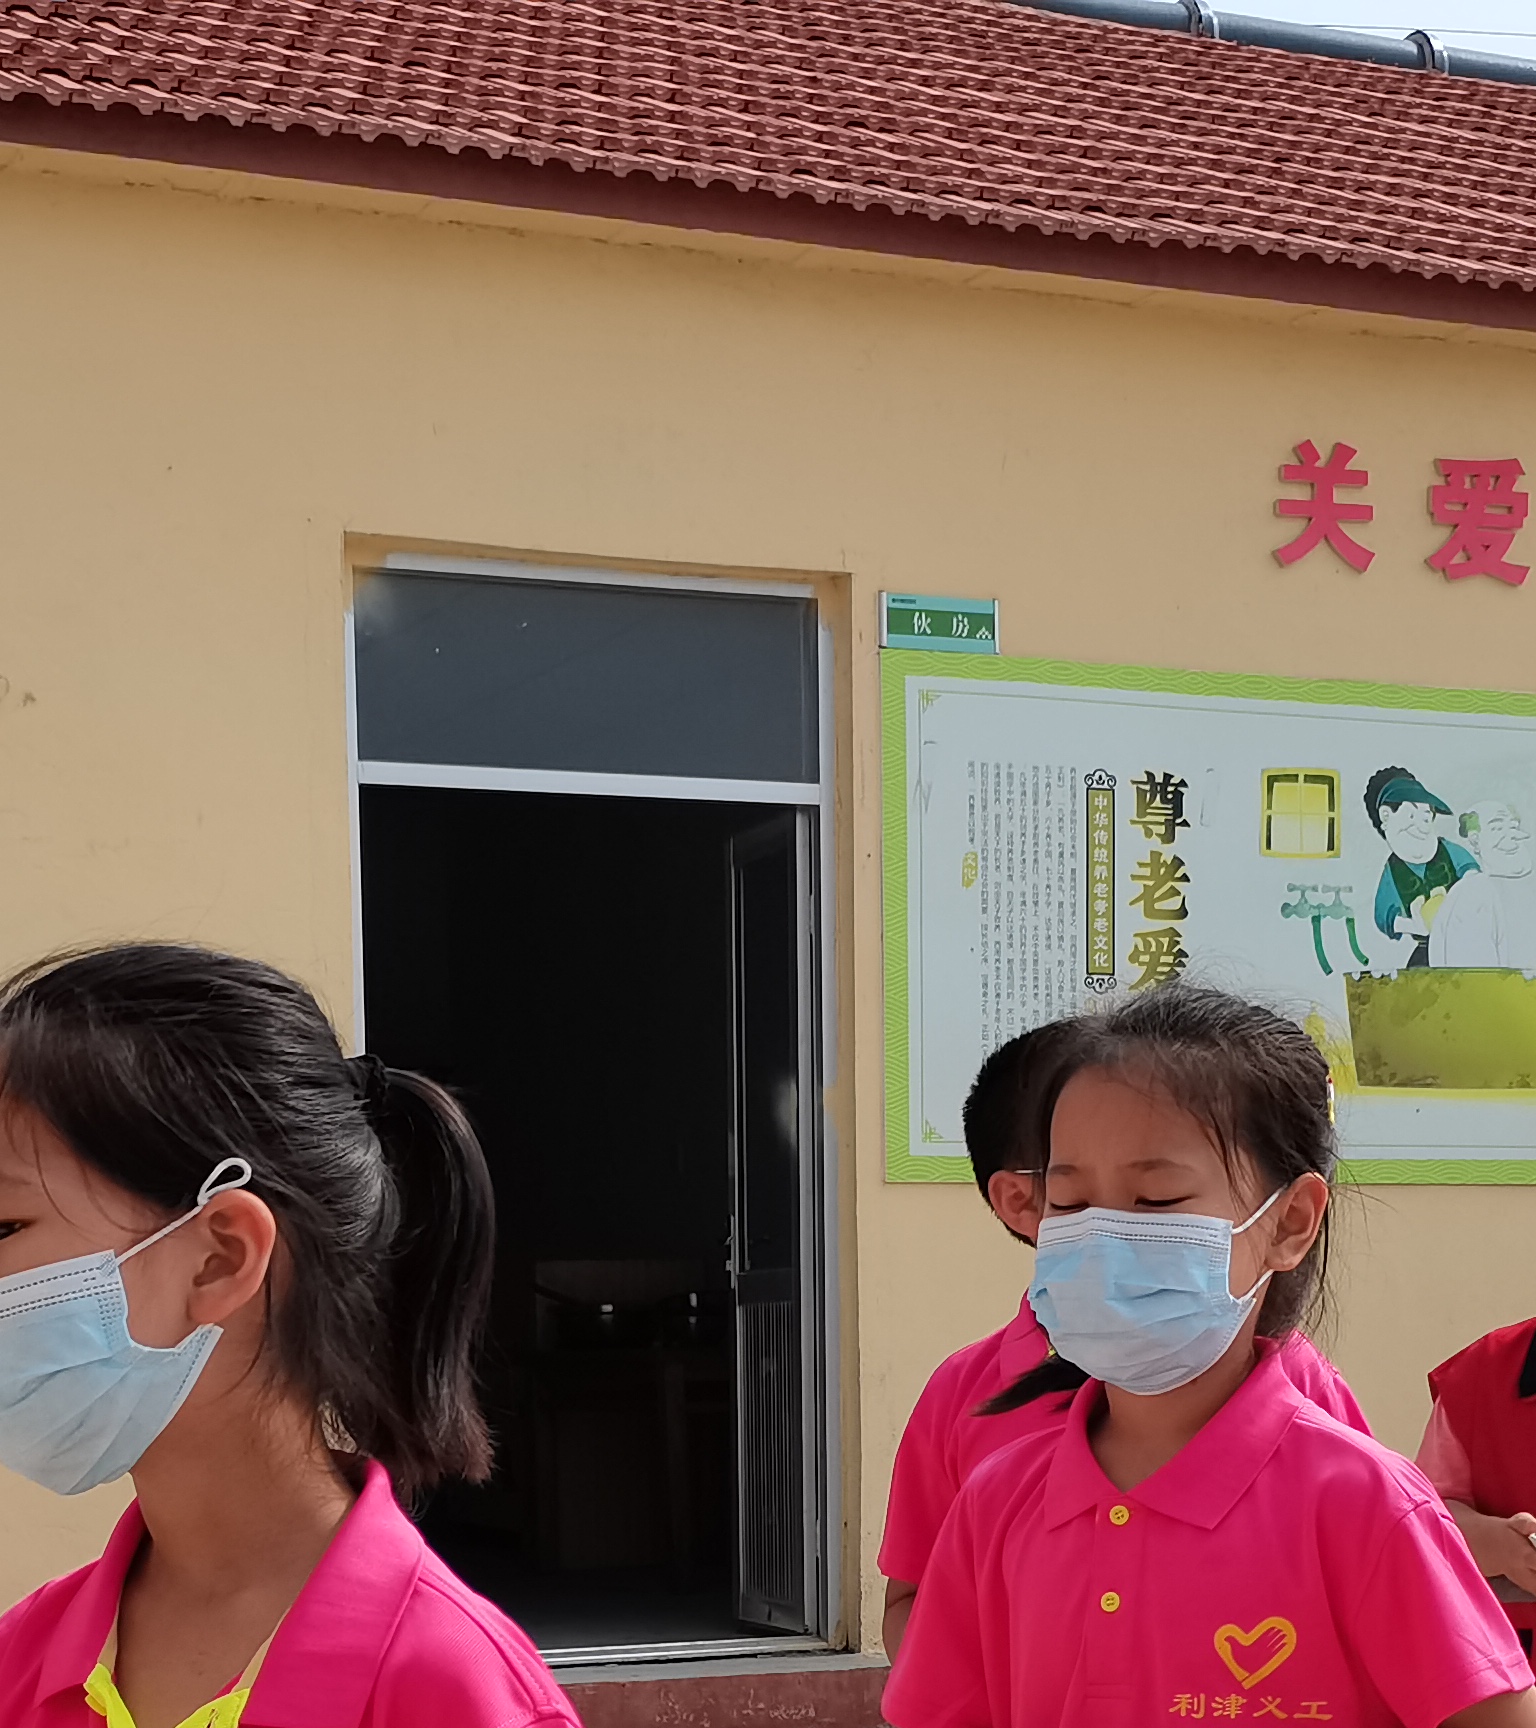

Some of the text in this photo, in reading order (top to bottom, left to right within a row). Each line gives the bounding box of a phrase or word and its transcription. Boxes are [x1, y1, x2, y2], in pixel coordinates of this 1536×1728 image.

[913, 611, 970, 638] 伙房
[1093, 793, 1110, 969] 中华传统养老孝老文化
[1128, 769, 1191, 991] 尊老爱
[1168, 1693, 1333, 1720] 利津义工
